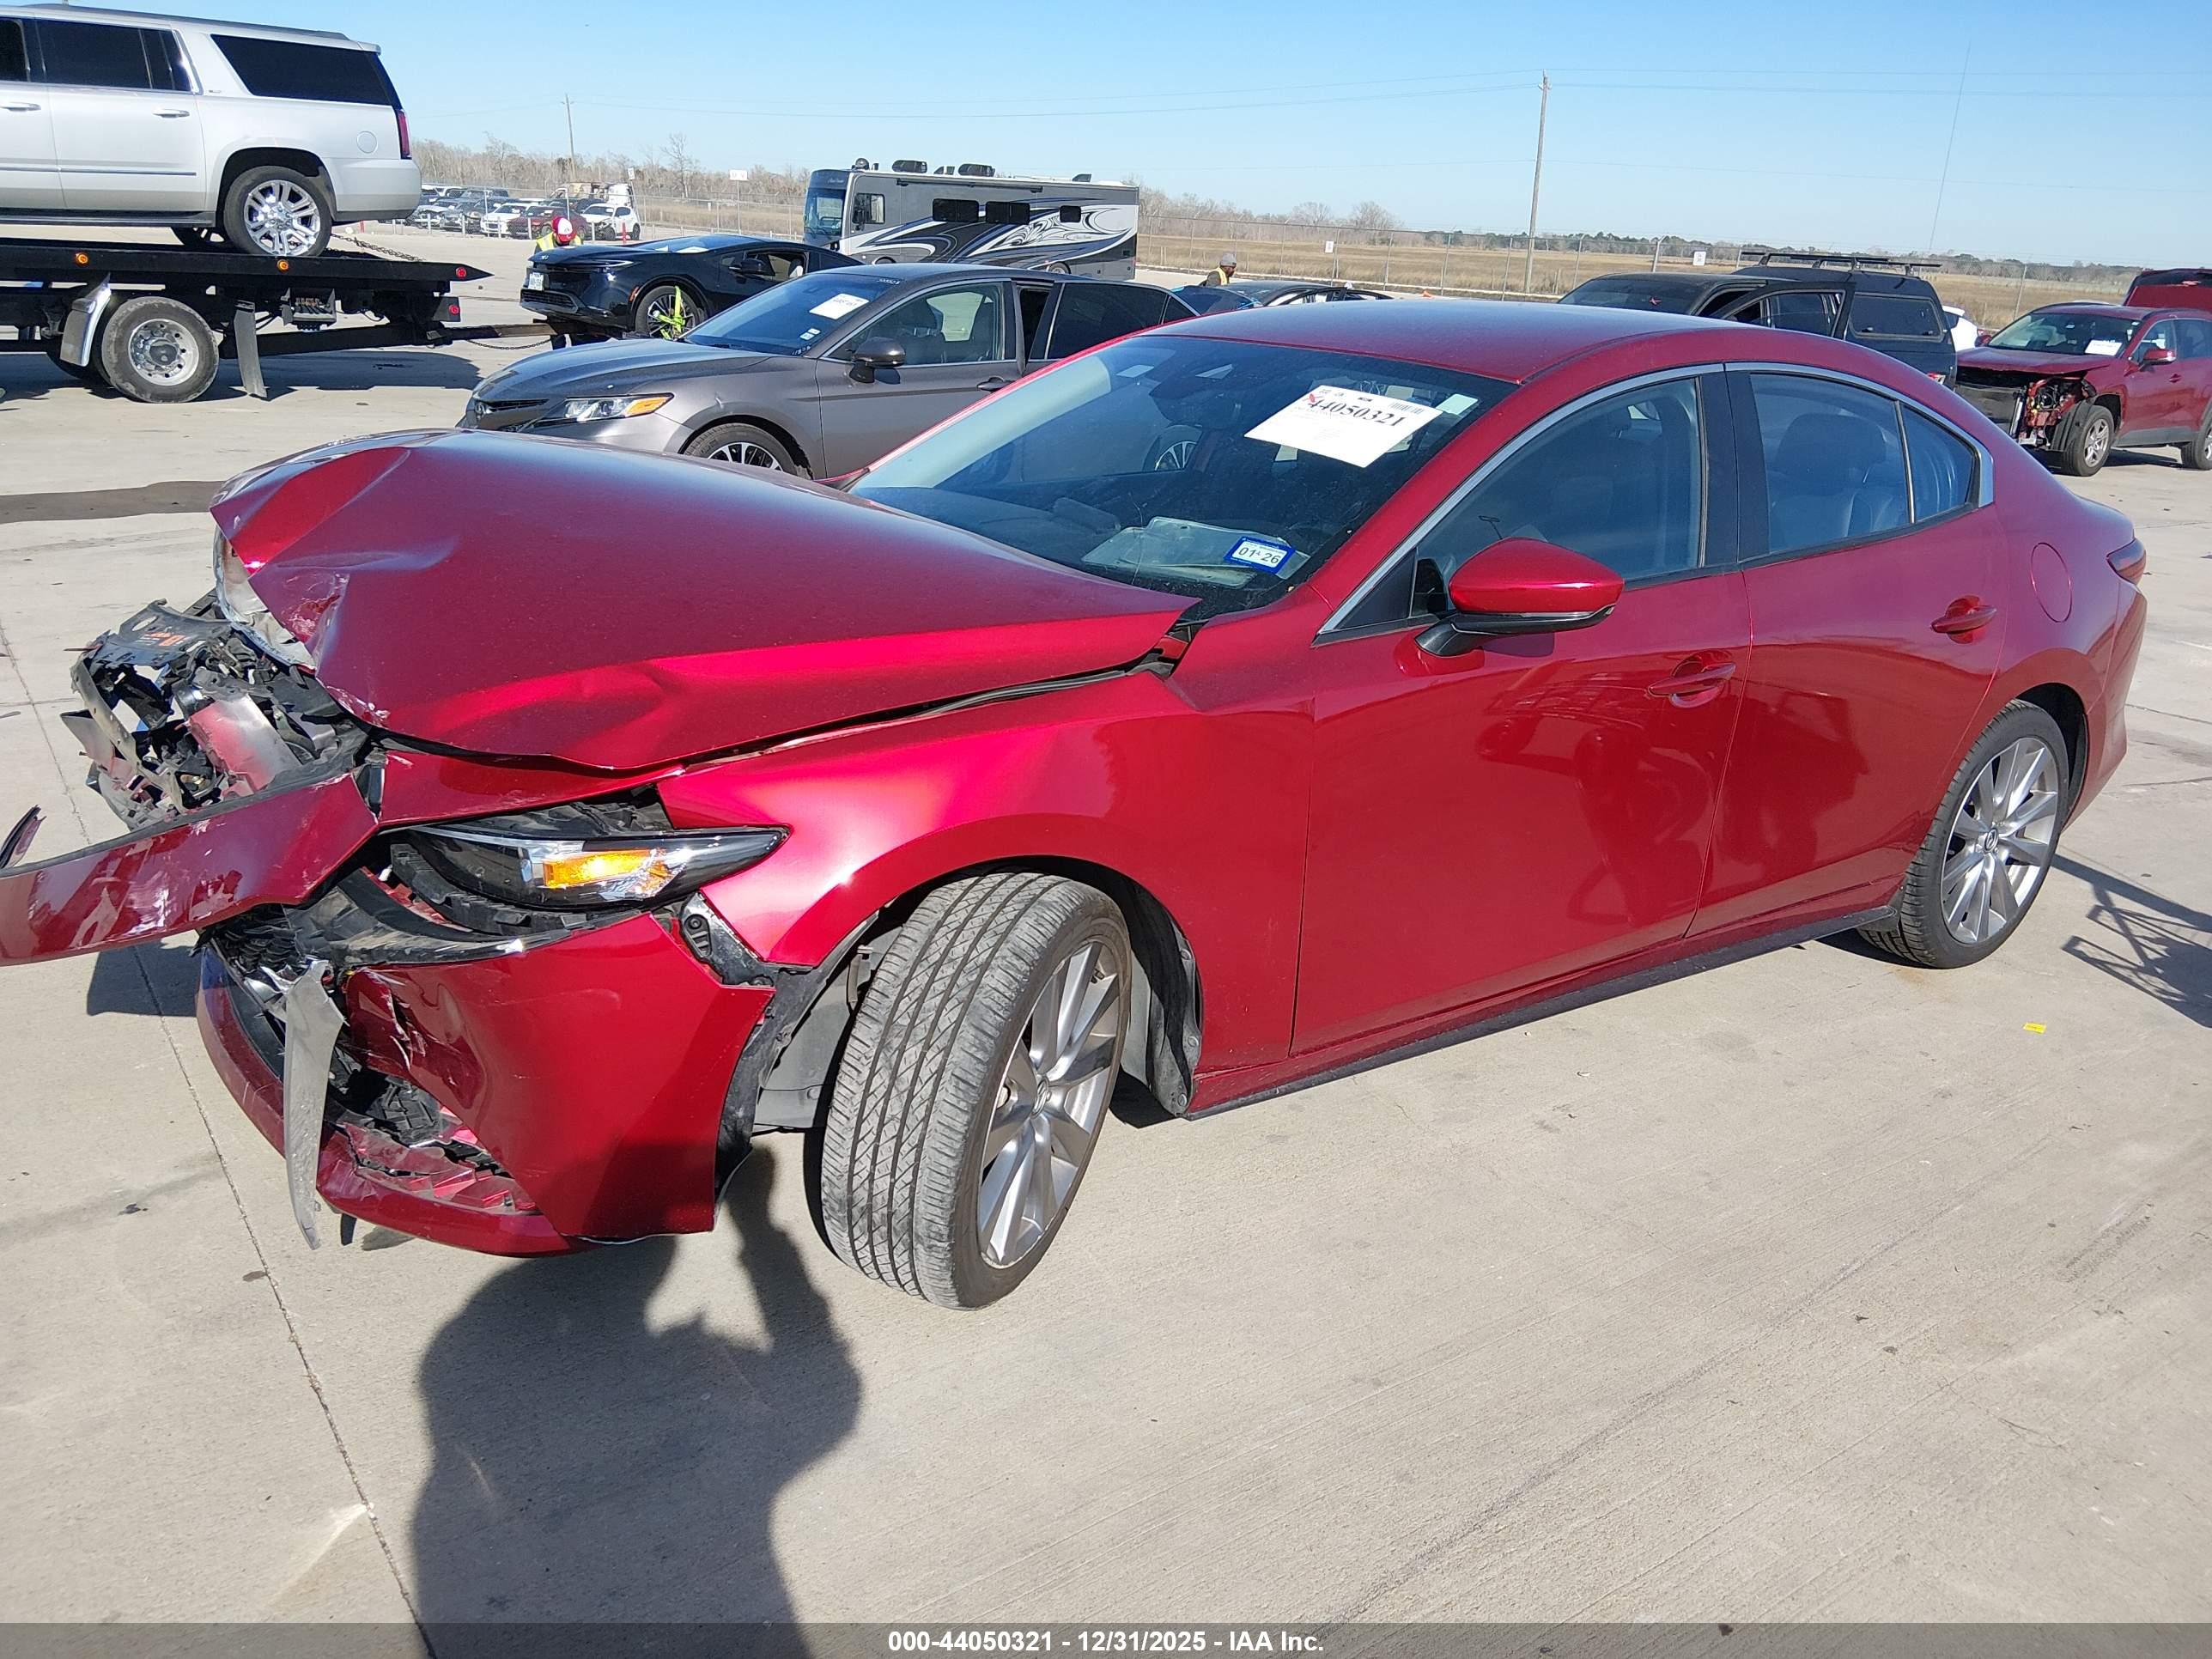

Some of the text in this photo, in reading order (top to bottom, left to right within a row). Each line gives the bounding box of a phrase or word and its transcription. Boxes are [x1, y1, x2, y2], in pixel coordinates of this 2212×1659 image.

[1308, 398, 1407, 426] 44050321
[1238, 547, 1256, 558] 01
[1261, 552, 1282, 564] 26
